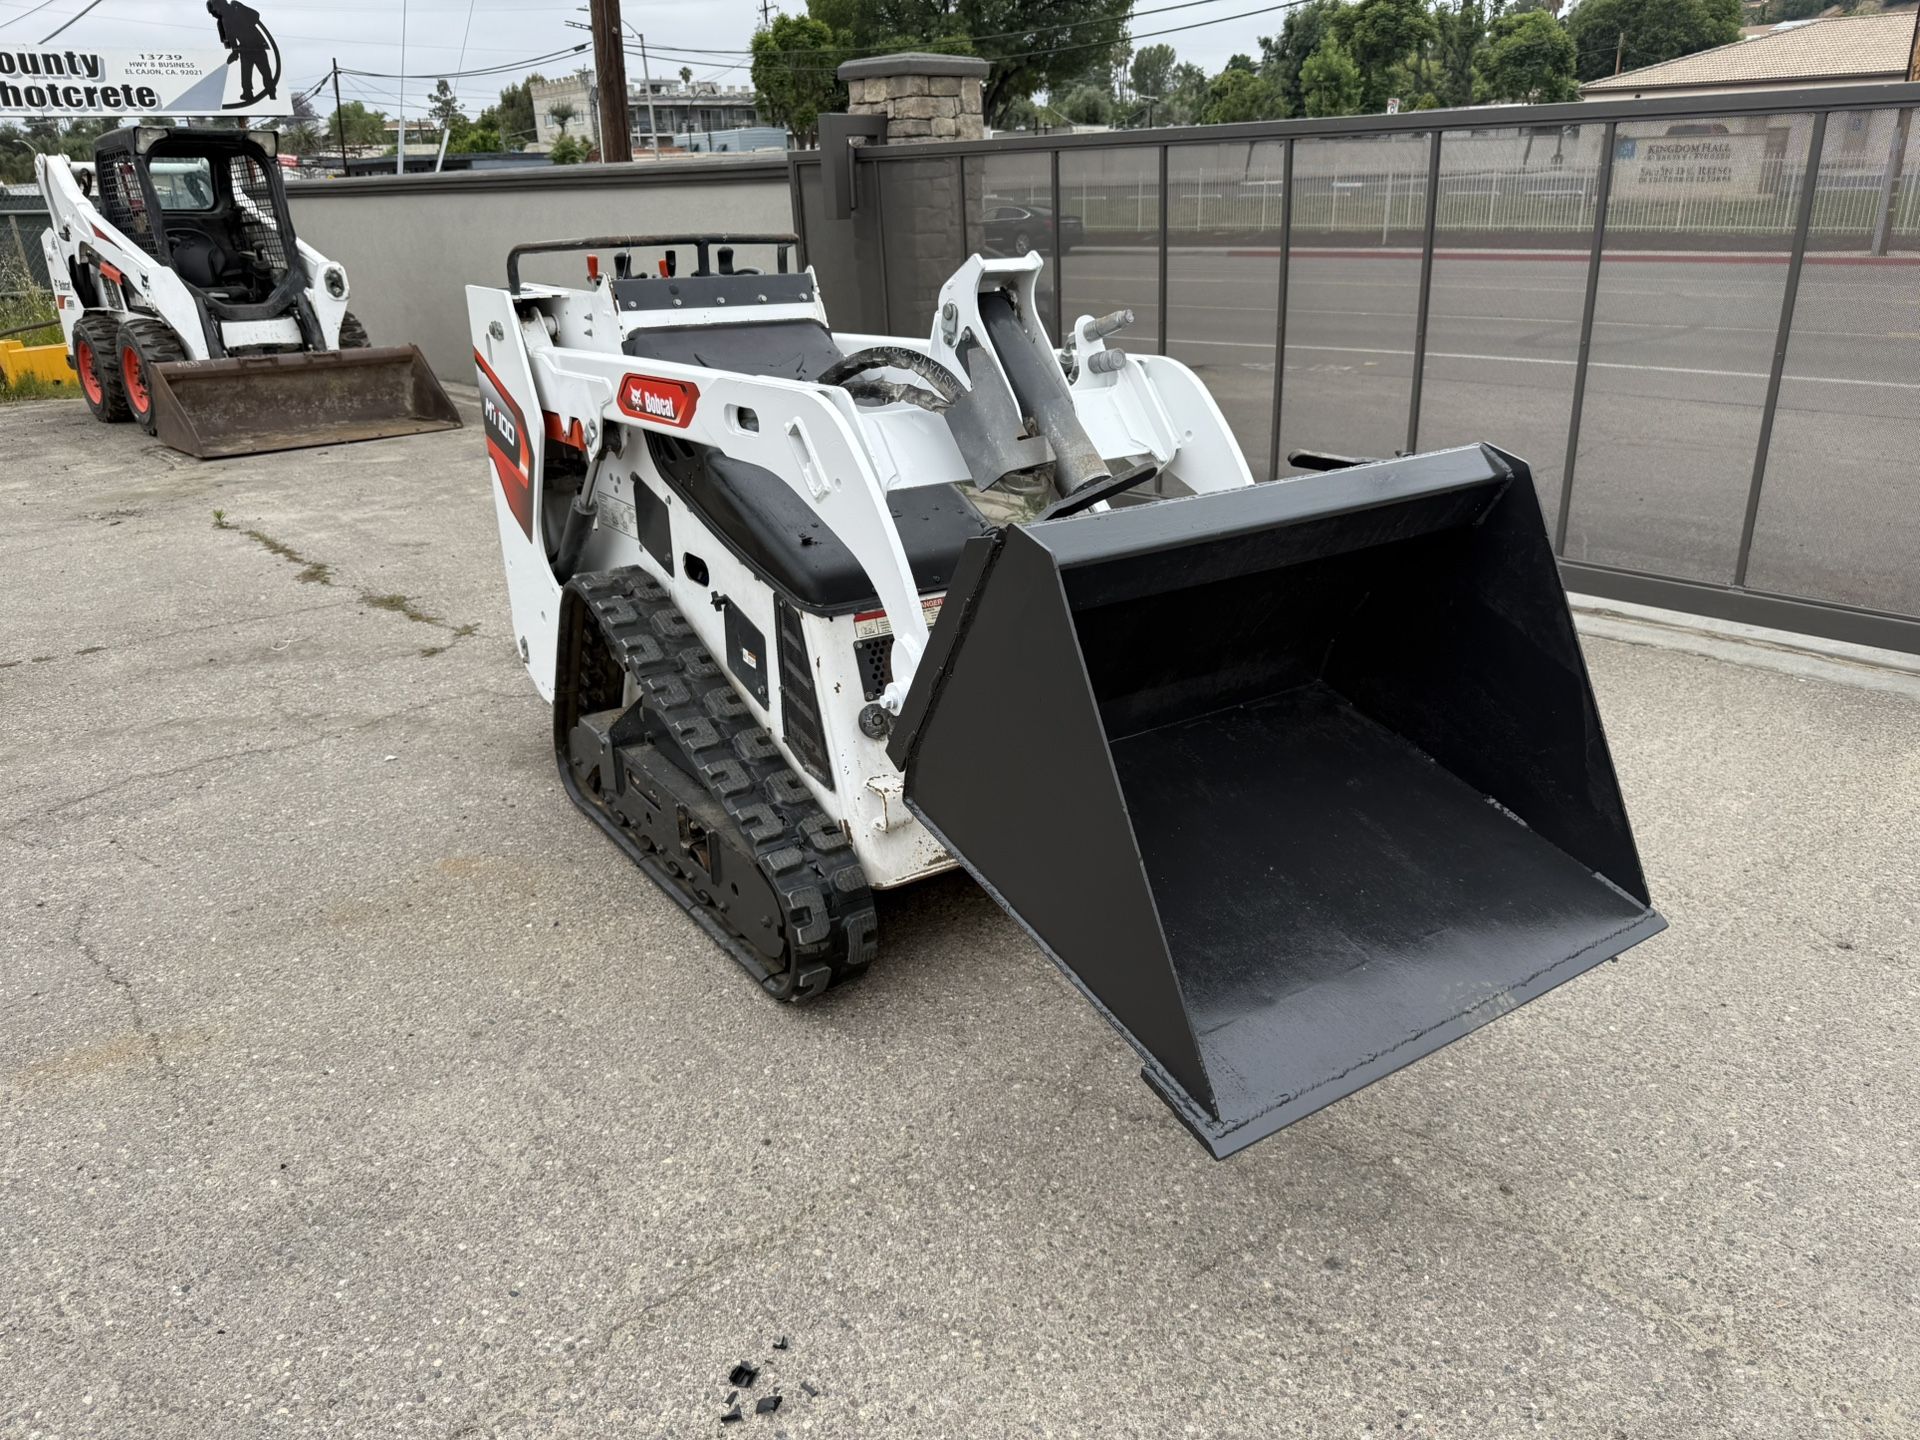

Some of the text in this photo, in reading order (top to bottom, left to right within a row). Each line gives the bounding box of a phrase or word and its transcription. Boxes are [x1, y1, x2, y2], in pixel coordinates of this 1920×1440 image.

[0, 51, 99, 78] ounty
[0, 81, 157, 108] hotcrete
[1648, 143, 1700, 154] KINGDOM
[644, 391, 676, 418] Bobcat
[920, 598, 943, 609] ANGER
